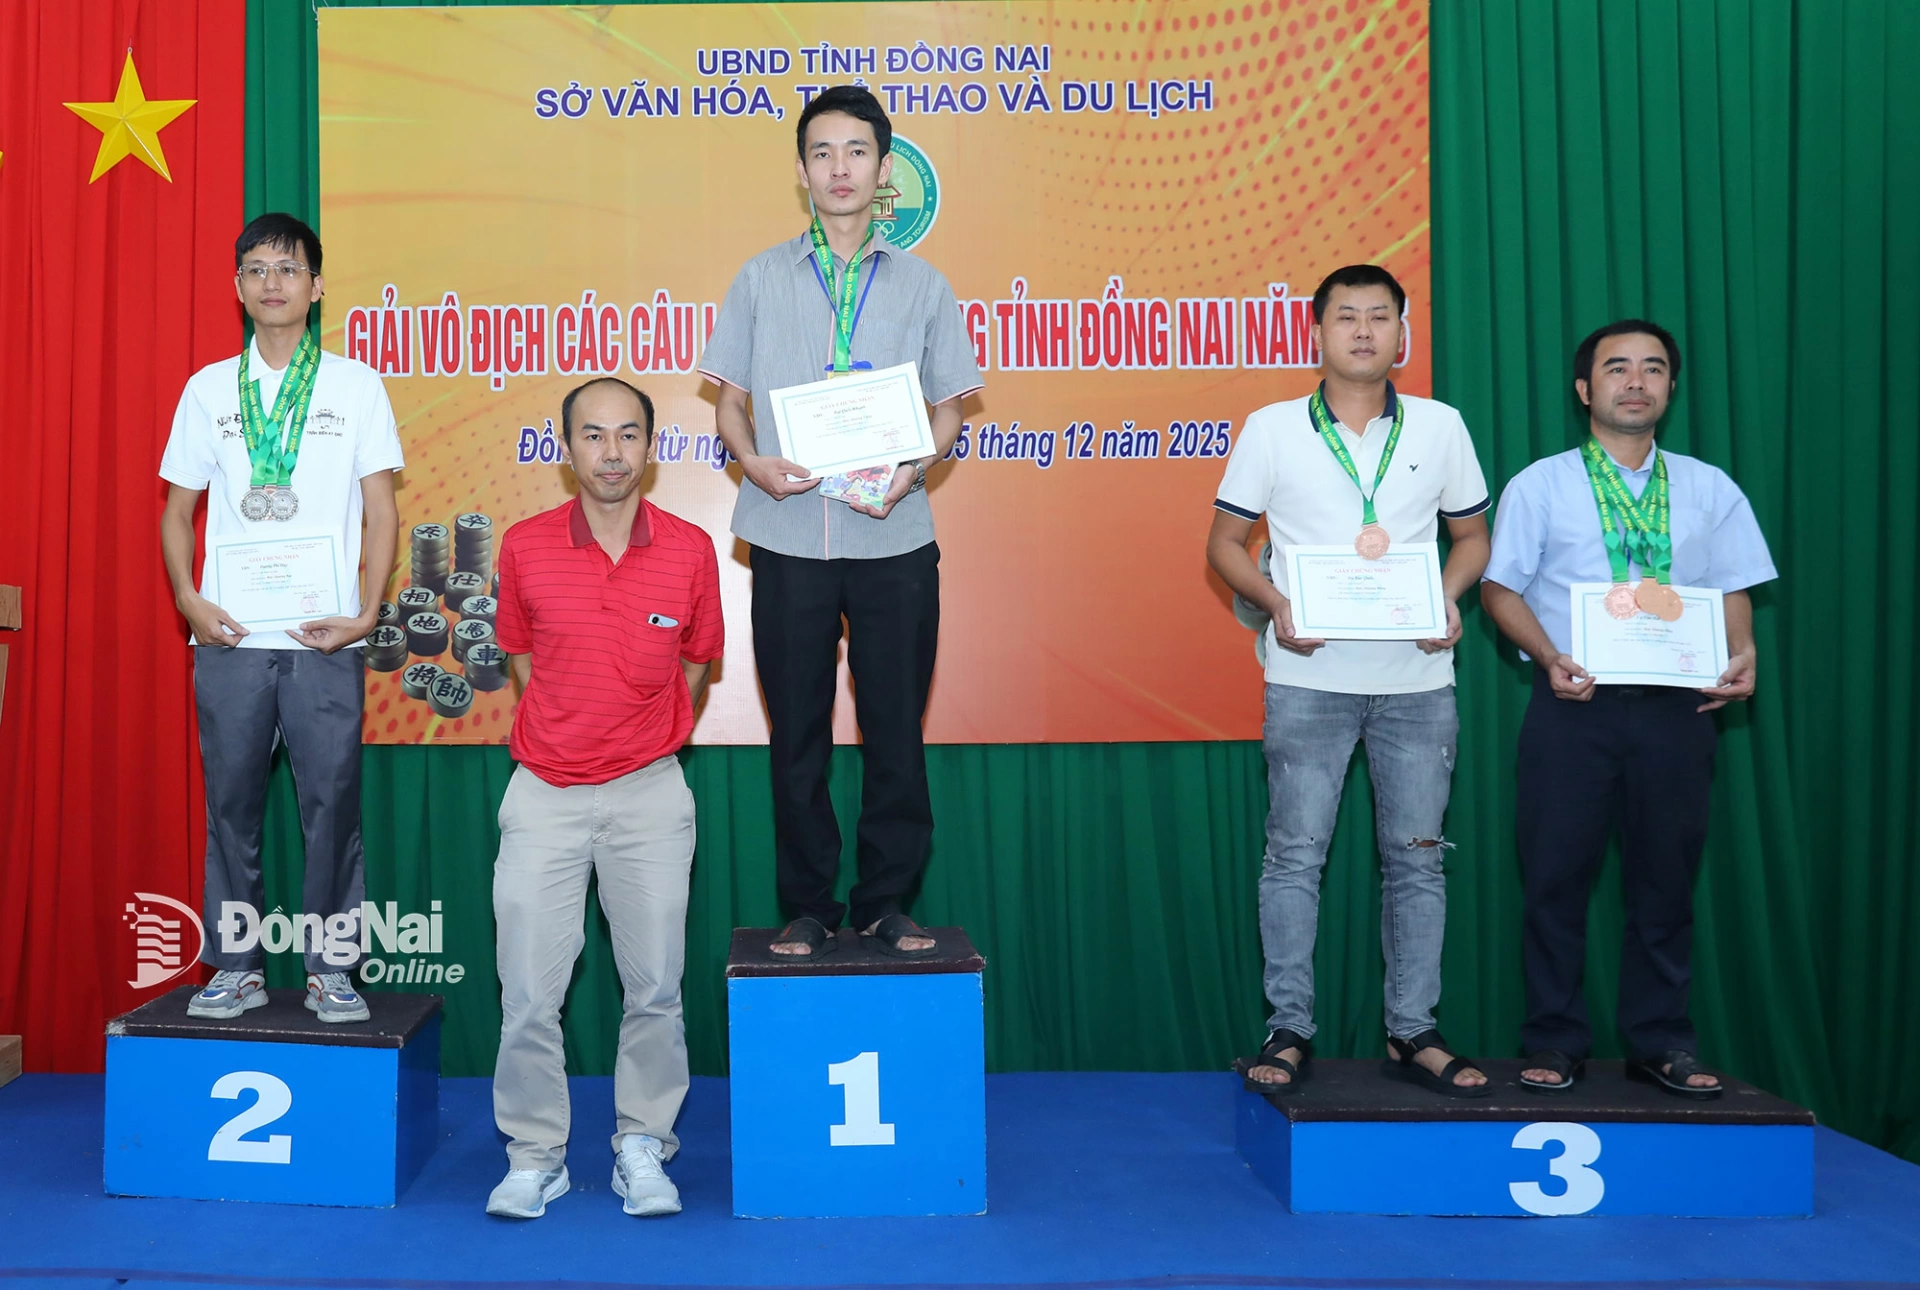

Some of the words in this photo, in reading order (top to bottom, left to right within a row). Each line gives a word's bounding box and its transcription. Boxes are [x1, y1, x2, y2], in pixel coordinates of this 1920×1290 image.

[697, 48, 791, 75] UBND
[800, 42, 876, 74] TỈNH
[884, 42, 984, 73] ĐỒNG
[995, 46, 1050, 72] NAI
[535, 82, 592, 118] SỞ
[602, 81, 680, 117] VĂN
[693, 81, 785, 120] HÓA,
[881, 84, 988, 112] THAO
[998, 75, 1052, 112] VÀ
[1062, 82, 1114, 111] DU
[1128, 81, 1212, 118] LỊCH
[912, 210, 931, 237] TOURISM
[819, 244, 828, 261] THAO
[348, 286, 410, 374] GIẢI
[419, 293, 461, 374] VÔ
[470, 307, 545, 389] ĐỊCH
[556, 292, 619, 373] CÁC
[630, 292, 694, 373] CÂU
[996, 280, 1070, 368] TỈNH
[1080, 279, 1168, 368] ĐỒNG
[1180, 301, 1233, 366] NAI
[1244, 286, 1319, 365] NĂM
[289, 365, 299, 382] THAO
[1319, 418, 1328, 432] THAO
[658, 428, 689, 462] từ
[944, 424, 971, 460] 5
[979, 423, 1056, 468] tháng
[1064, 422, 1095, 458] 12
[1101, 422, 1160, 458] năm
[1168, 421, 1231, 457] 2025
[1609, 473, 1620, 489] THAO
[1631, 507, 1639, 518] NAI
[449, 573, 480, 586] 仕
[402, 588, 430, 604] 相
[412, 615, 441, 632] 炮
[471, 644, 503, 665] 車
[435, 675, 468, 706] 帥
[828, 1051, 895, 1147] 1
[208, 1070, 292, 1165] 2
[1509, 1121, 1605, 1217] 3
